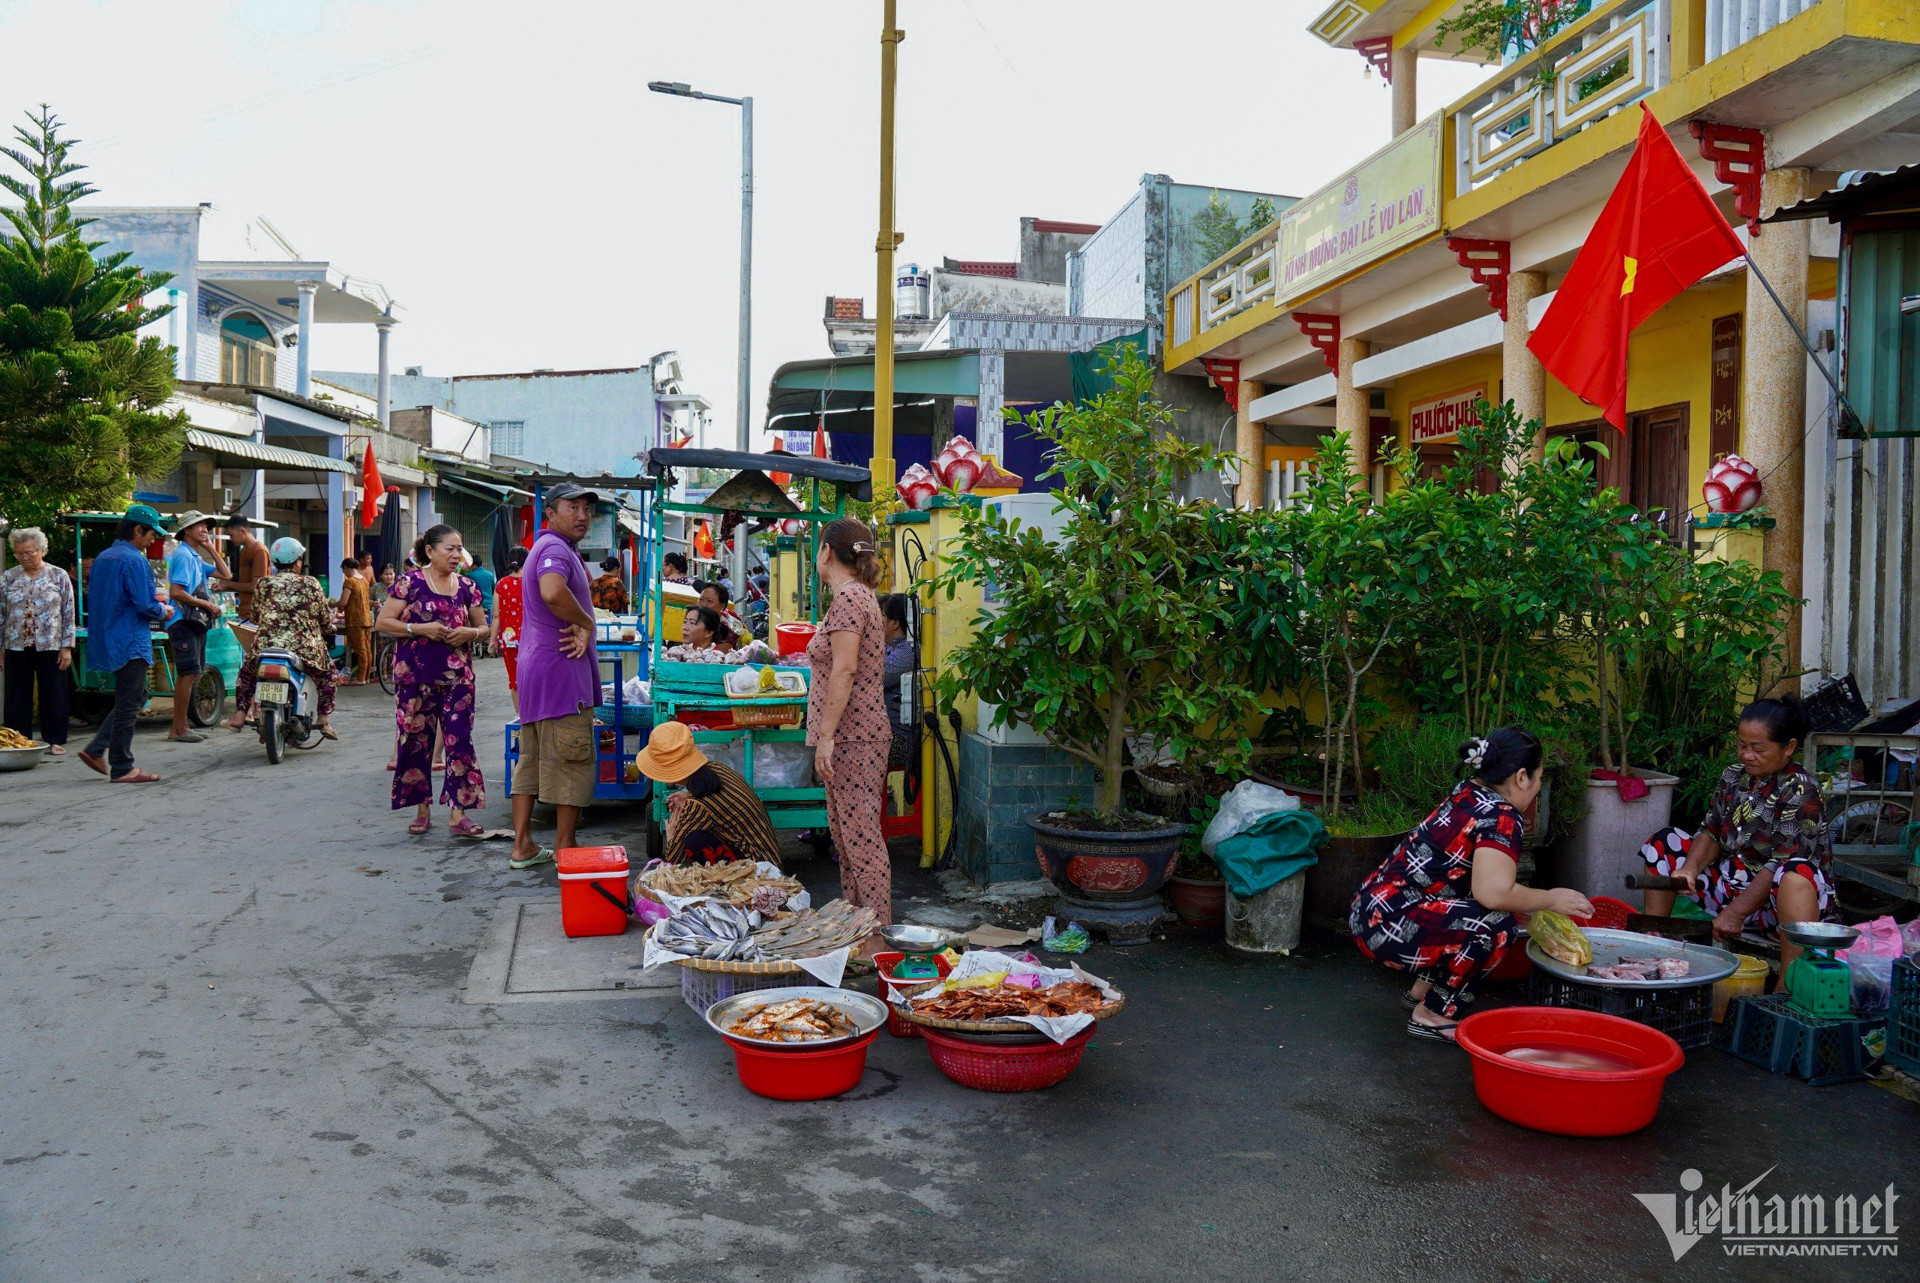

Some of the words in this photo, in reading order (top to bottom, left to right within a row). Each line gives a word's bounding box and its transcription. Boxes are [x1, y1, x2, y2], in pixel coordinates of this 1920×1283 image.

[1340, 223, 1359, 255] ĐẠI
[1361, 202, 1376, 244] LỄ
[1380, 204, 1396, 234] VU
[1398, 188, 1423, 225] LAN
[1412, 400, 1454, 441] PHƯỚC
